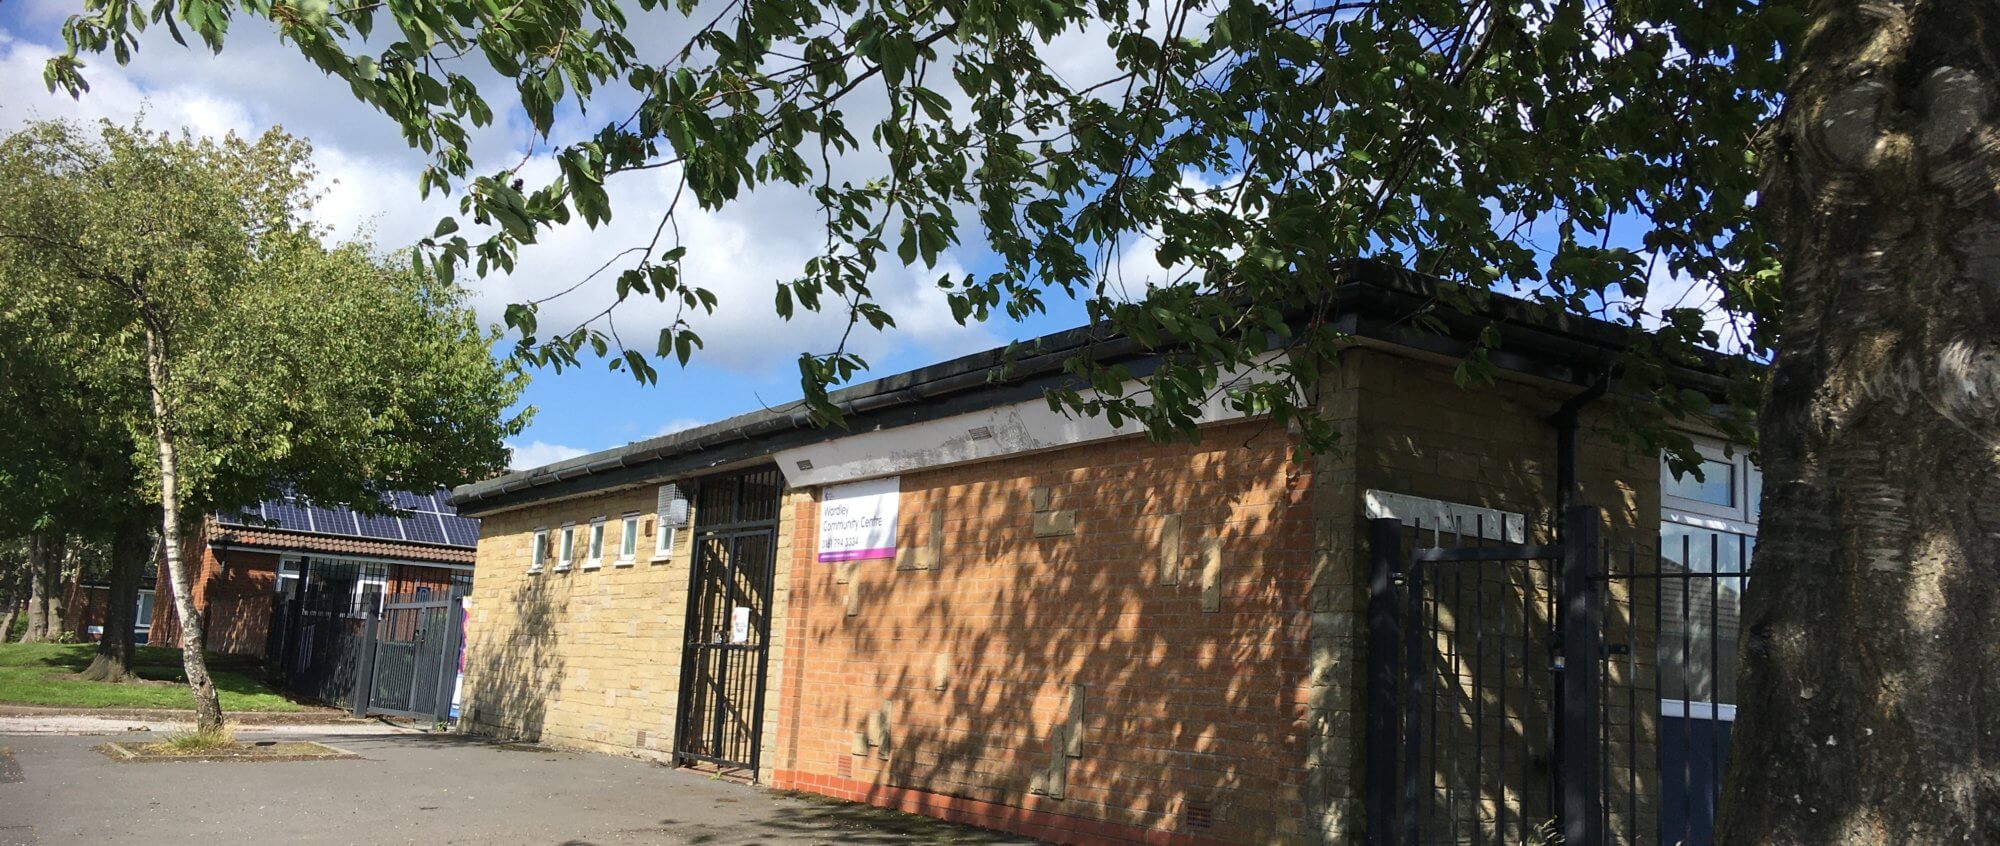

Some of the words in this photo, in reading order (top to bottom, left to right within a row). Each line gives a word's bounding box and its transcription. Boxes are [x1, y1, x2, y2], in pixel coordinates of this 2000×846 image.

[824, 504, 849, 518] Wardley
[823, 519, 859, 533] Community
[860, 515, 883, 529] Centre
